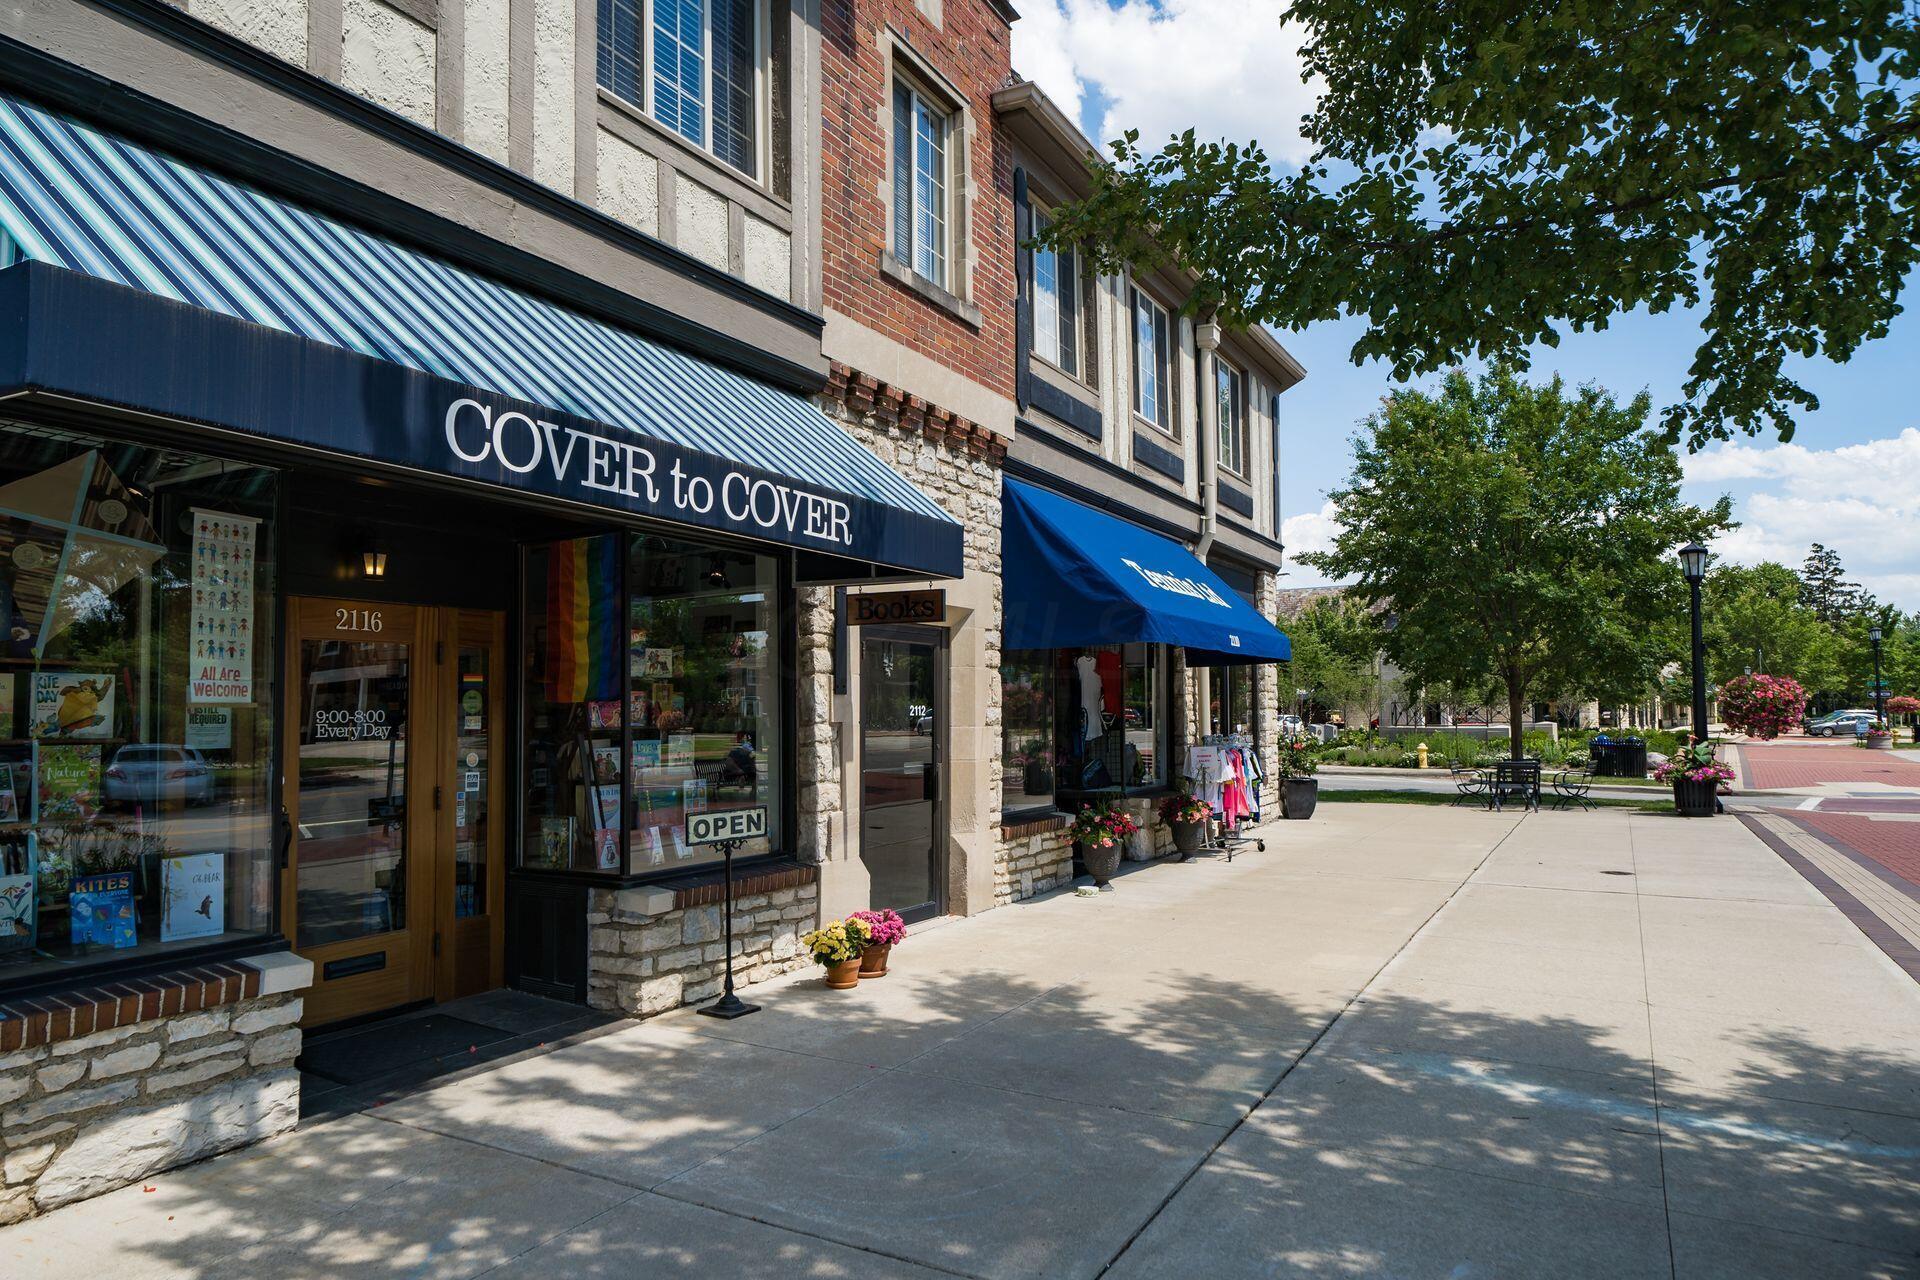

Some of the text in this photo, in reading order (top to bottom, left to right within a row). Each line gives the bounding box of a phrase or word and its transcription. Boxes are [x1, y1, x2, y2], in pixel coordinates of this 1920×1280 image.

[445, 398, 853, 546] COVER to COVER
[855, 594, 935, 621] Books
[335, 608, 383, 633] 2116
[200, 666, 241, 682] All Are
[36, 690, 60, 704] DAY
[193, 682, 249, 698] Welcome
[315, 710, 386, 724] 9:00-8:00
[909, 705, 927, 717] 2112
[189, 714, 227, 727] REQUIRED
[315, 724, 391, 740] Every Day
[47, 766, 87, 781] Nature
[693, 811, 762, 840] OPEN
[75, 876, 130, 894] KITES
